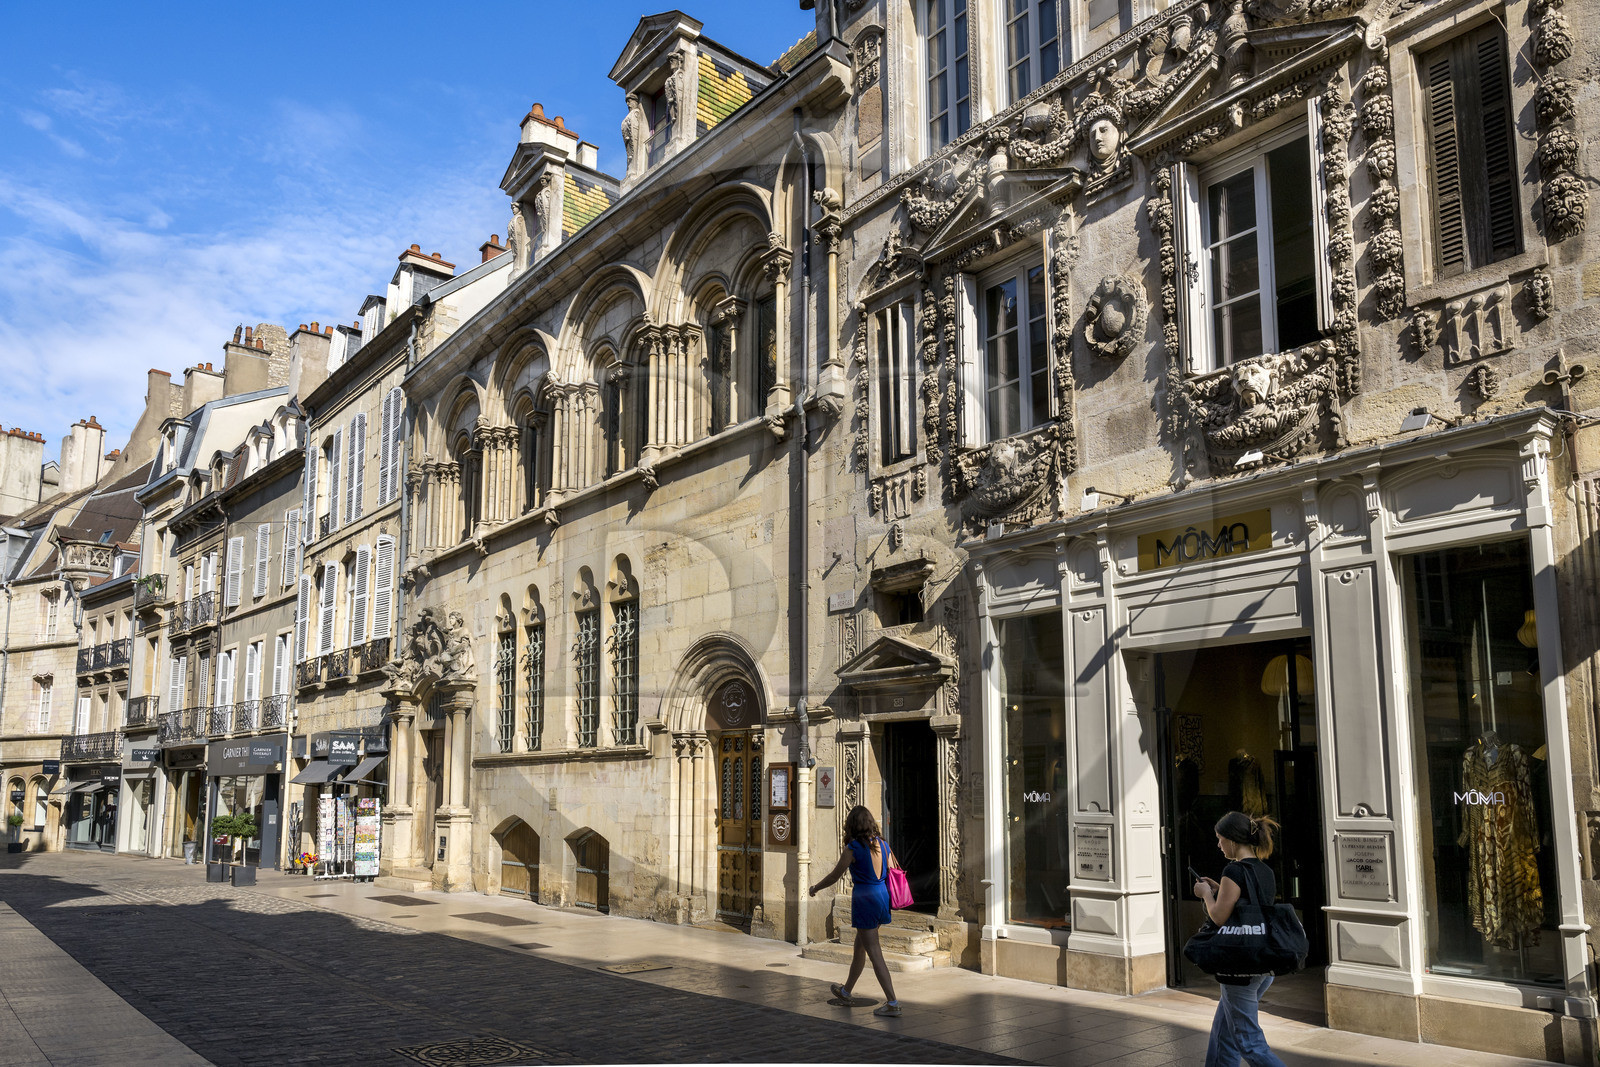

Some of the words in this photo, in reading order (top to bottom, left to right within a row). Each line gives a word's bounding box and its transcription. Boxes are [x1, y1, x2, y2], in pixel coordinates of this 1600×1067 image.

[1156, 522, 1250, 566] MÔMA
[332, 740, 356, 751] SAM
[223, 747, 241, 759] GARNIER
[1023, 790, 1051, 803] MÔMA
[1453, 788, 1506, 805] MÔMA
